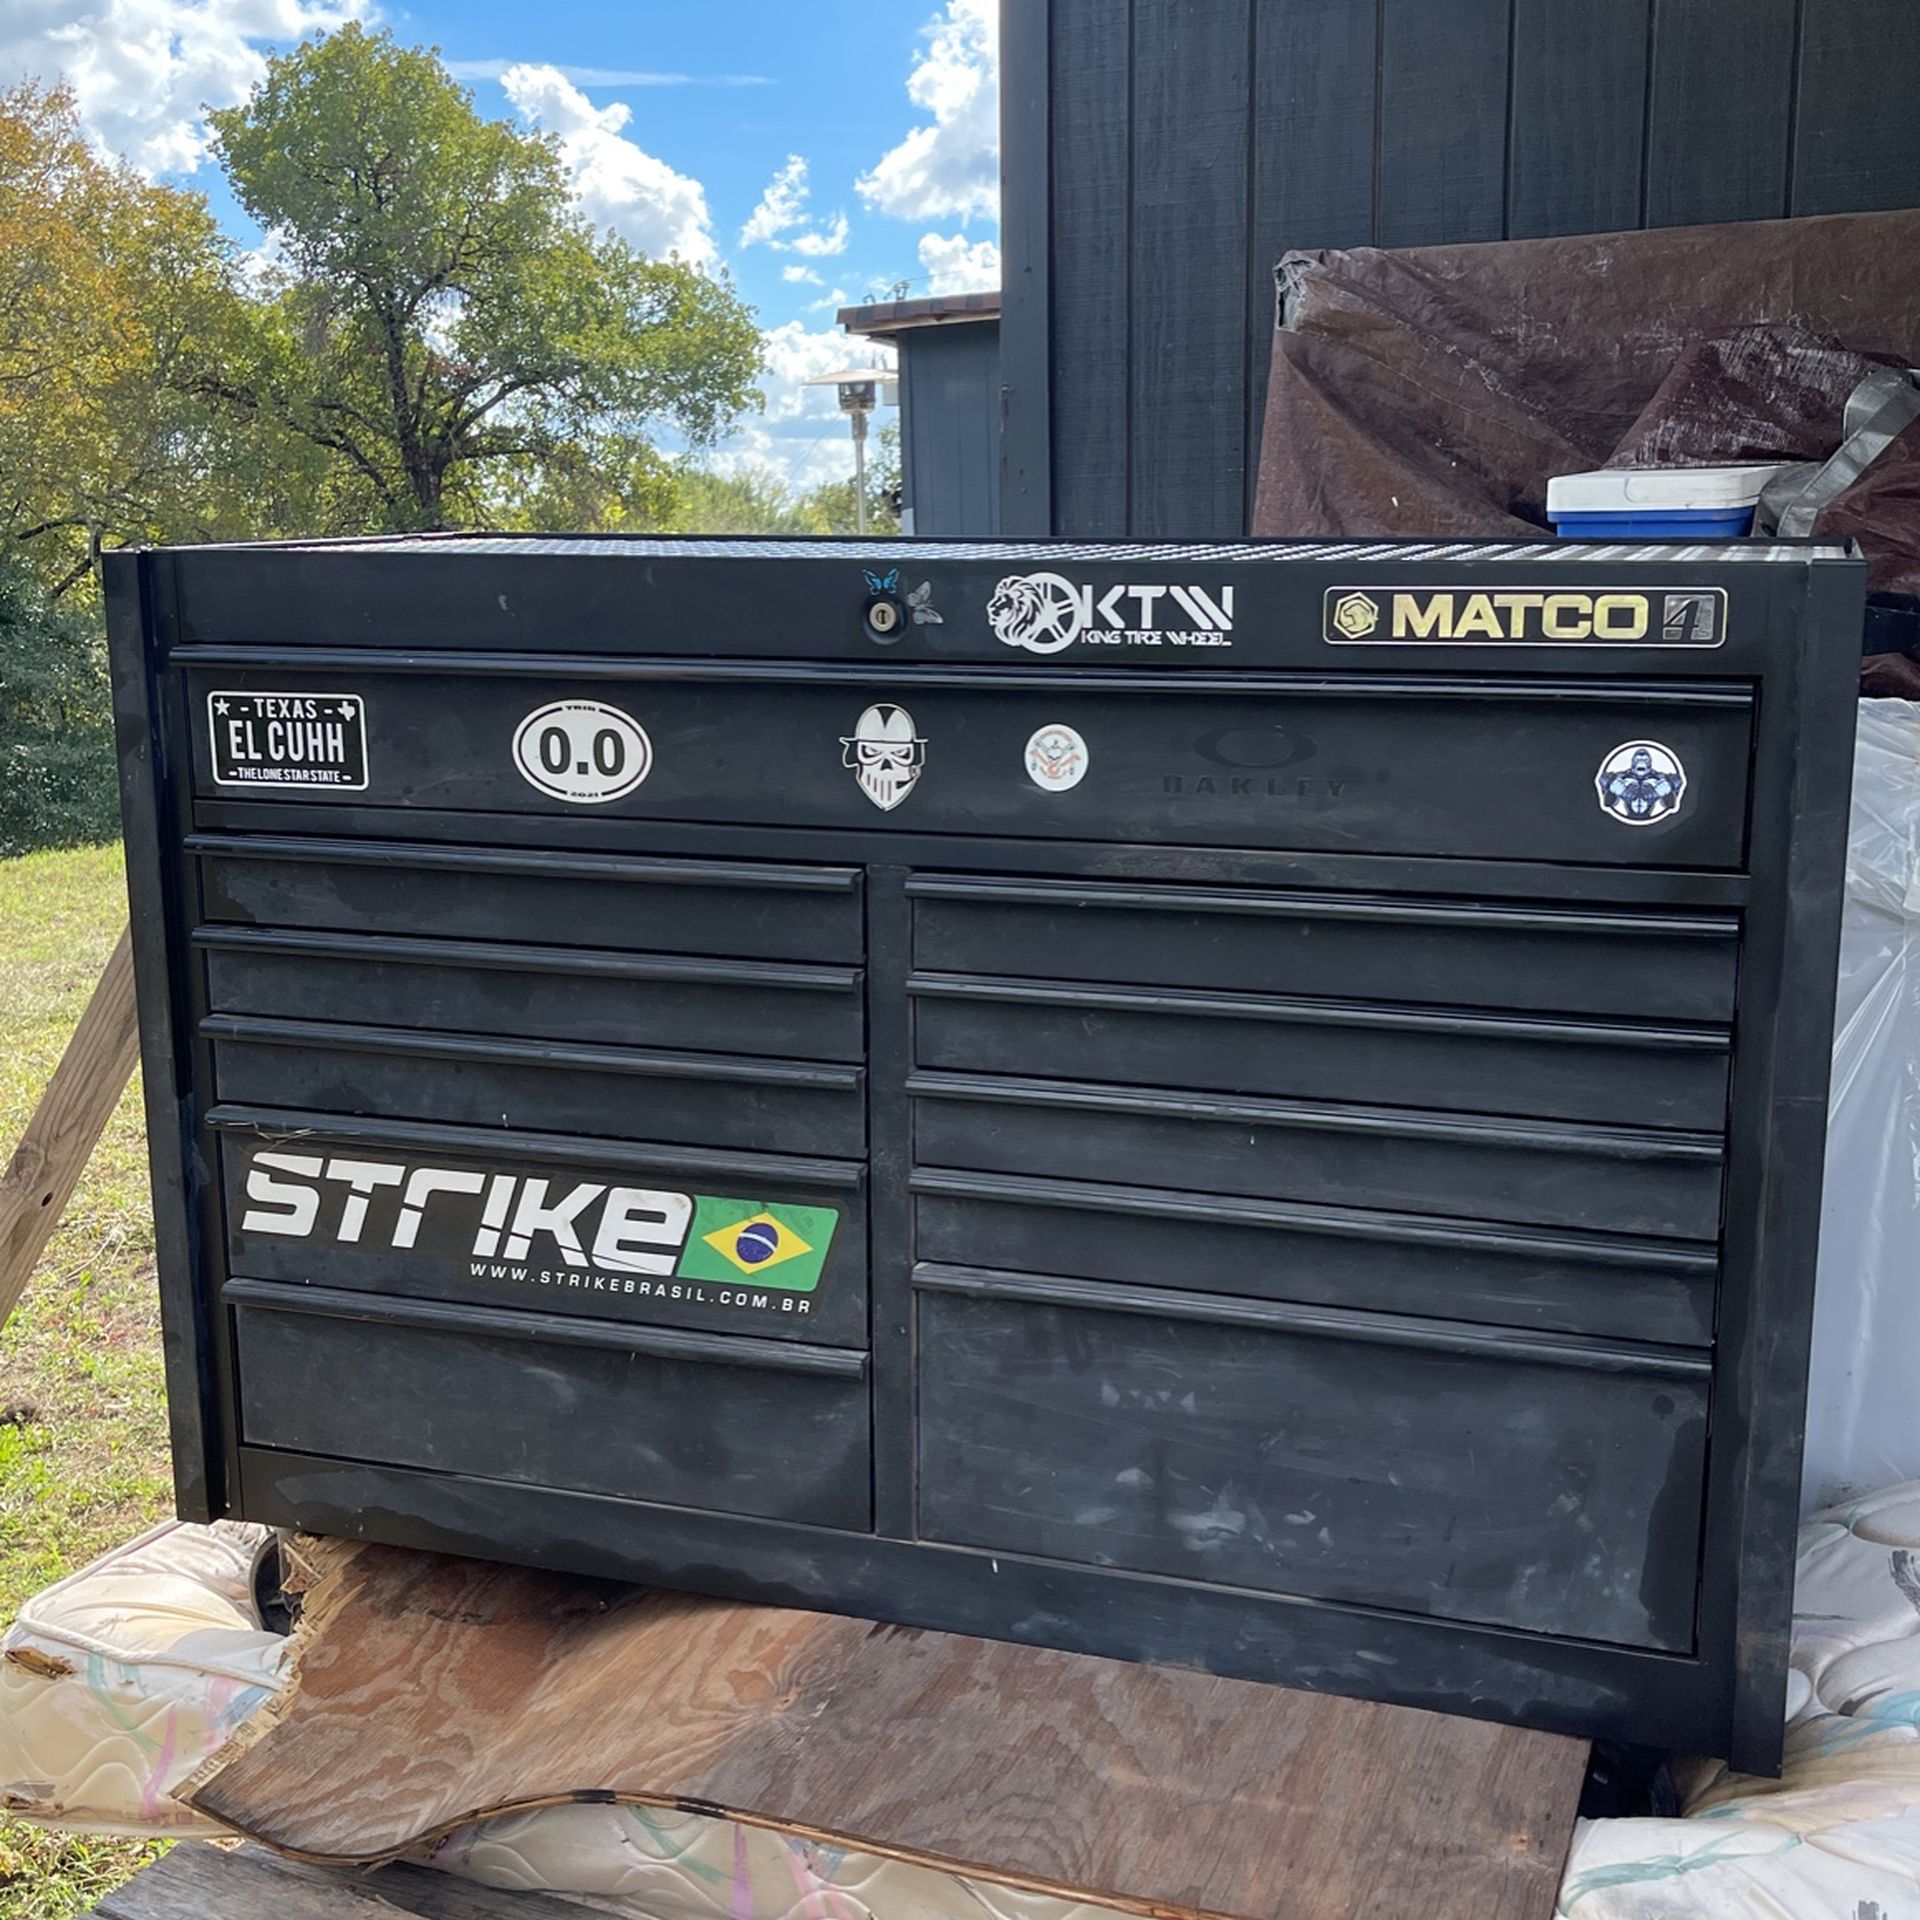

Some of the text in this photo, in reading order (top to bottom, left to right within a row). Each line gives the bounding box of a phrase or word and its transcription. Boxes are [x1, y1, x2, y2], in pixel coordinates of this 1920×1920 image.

[1082, 585, 1233, 630] KTW
[1392, 594, 1649, 639] MATCO
[1081, 630, 1232, 646] KING TIRE WHEEL
[253, 698, 317, 719] TEXAS
[229, 720, 344, 763] EL CUHH
[540, 727, 625, 777] 0.0
[1162, 774, 1348, 798] OAKLEY
[470, 1262, 812, 1314] WWW.STRIKEBRASIL.COM.BR
